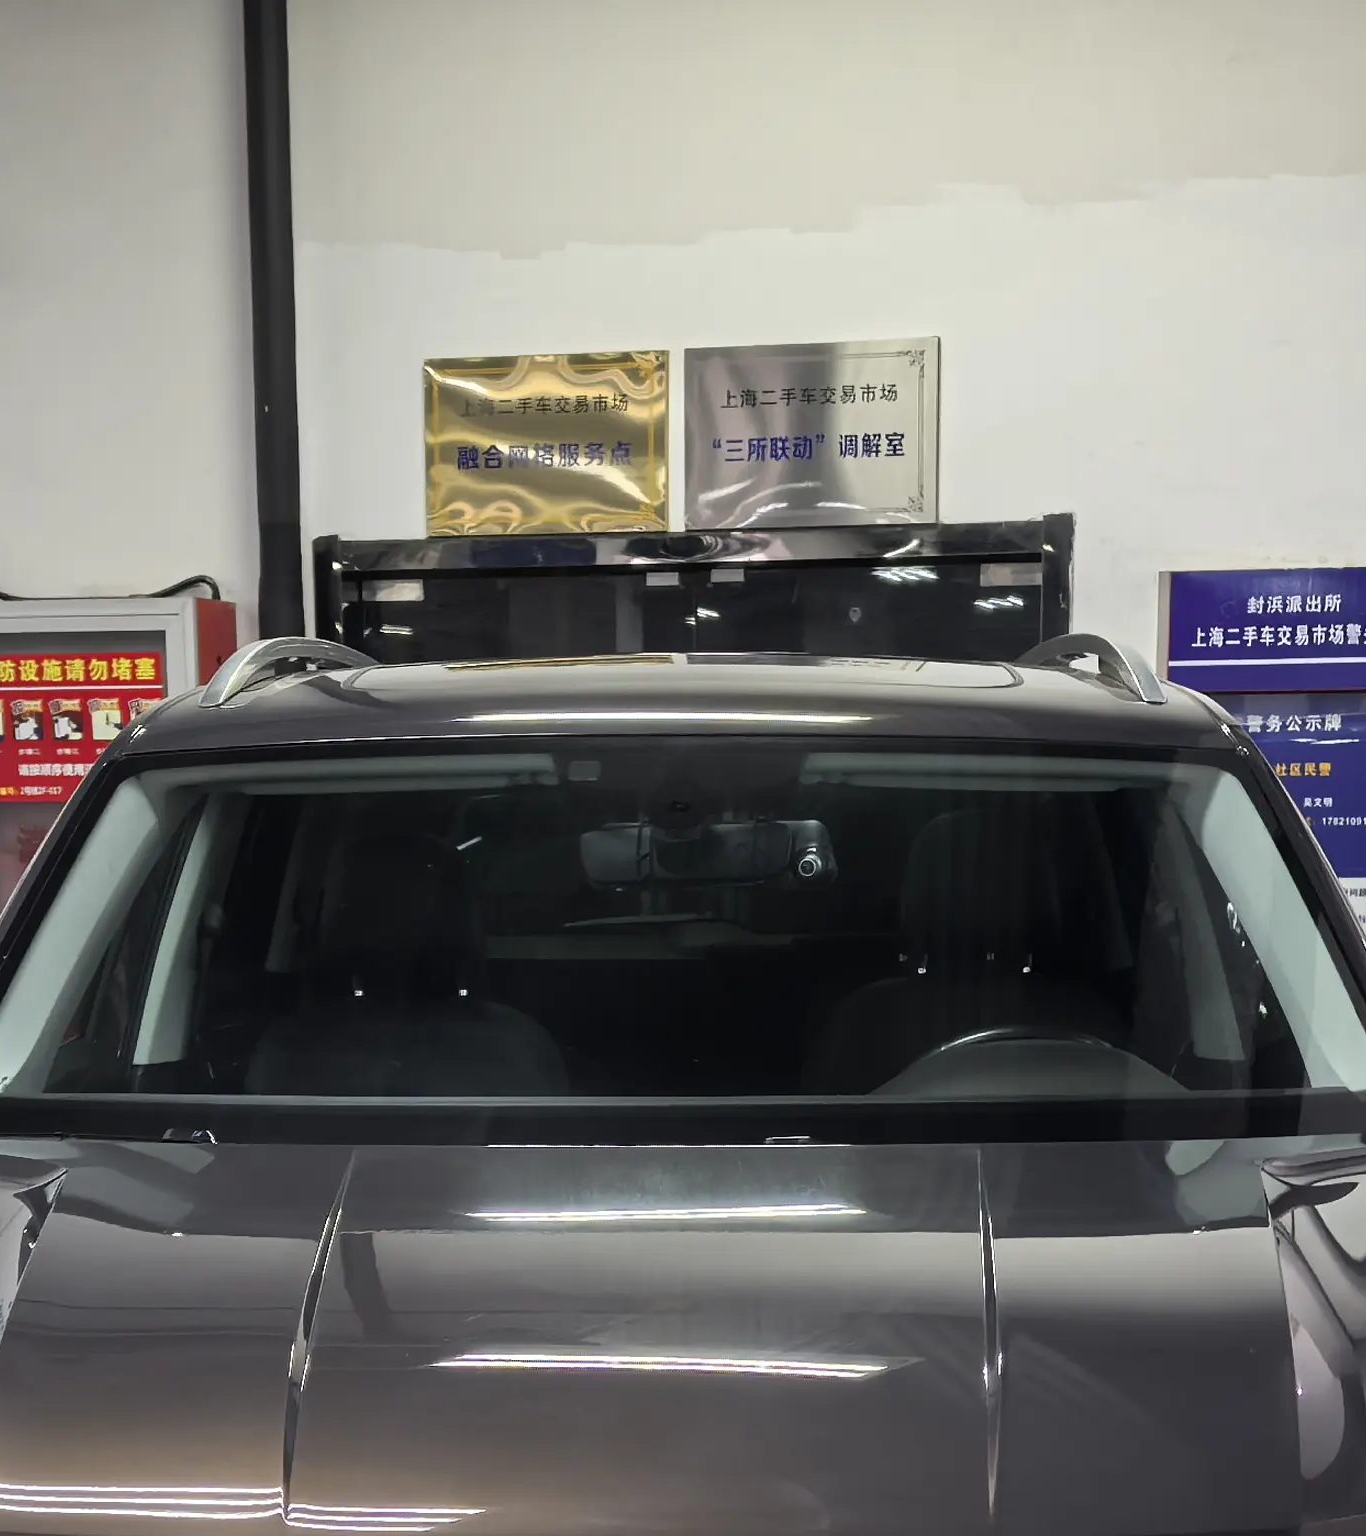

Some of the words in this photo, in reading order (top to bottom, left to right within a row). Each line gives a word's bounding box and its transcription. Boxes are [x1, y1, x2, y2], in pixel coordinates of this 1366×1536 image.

[461, 393, 628, 418] 上海二手车交易市场
[721, 383, 898, 408] 上海二手车交易市场
[457, 441, 632, 471] 融合网络服务点
[1247, 593, 1342, 614] 封浜派出所
[1246, 713, 1342, 733] 警务公示牌
[1275, 763, 1332, 777] 社区民警
